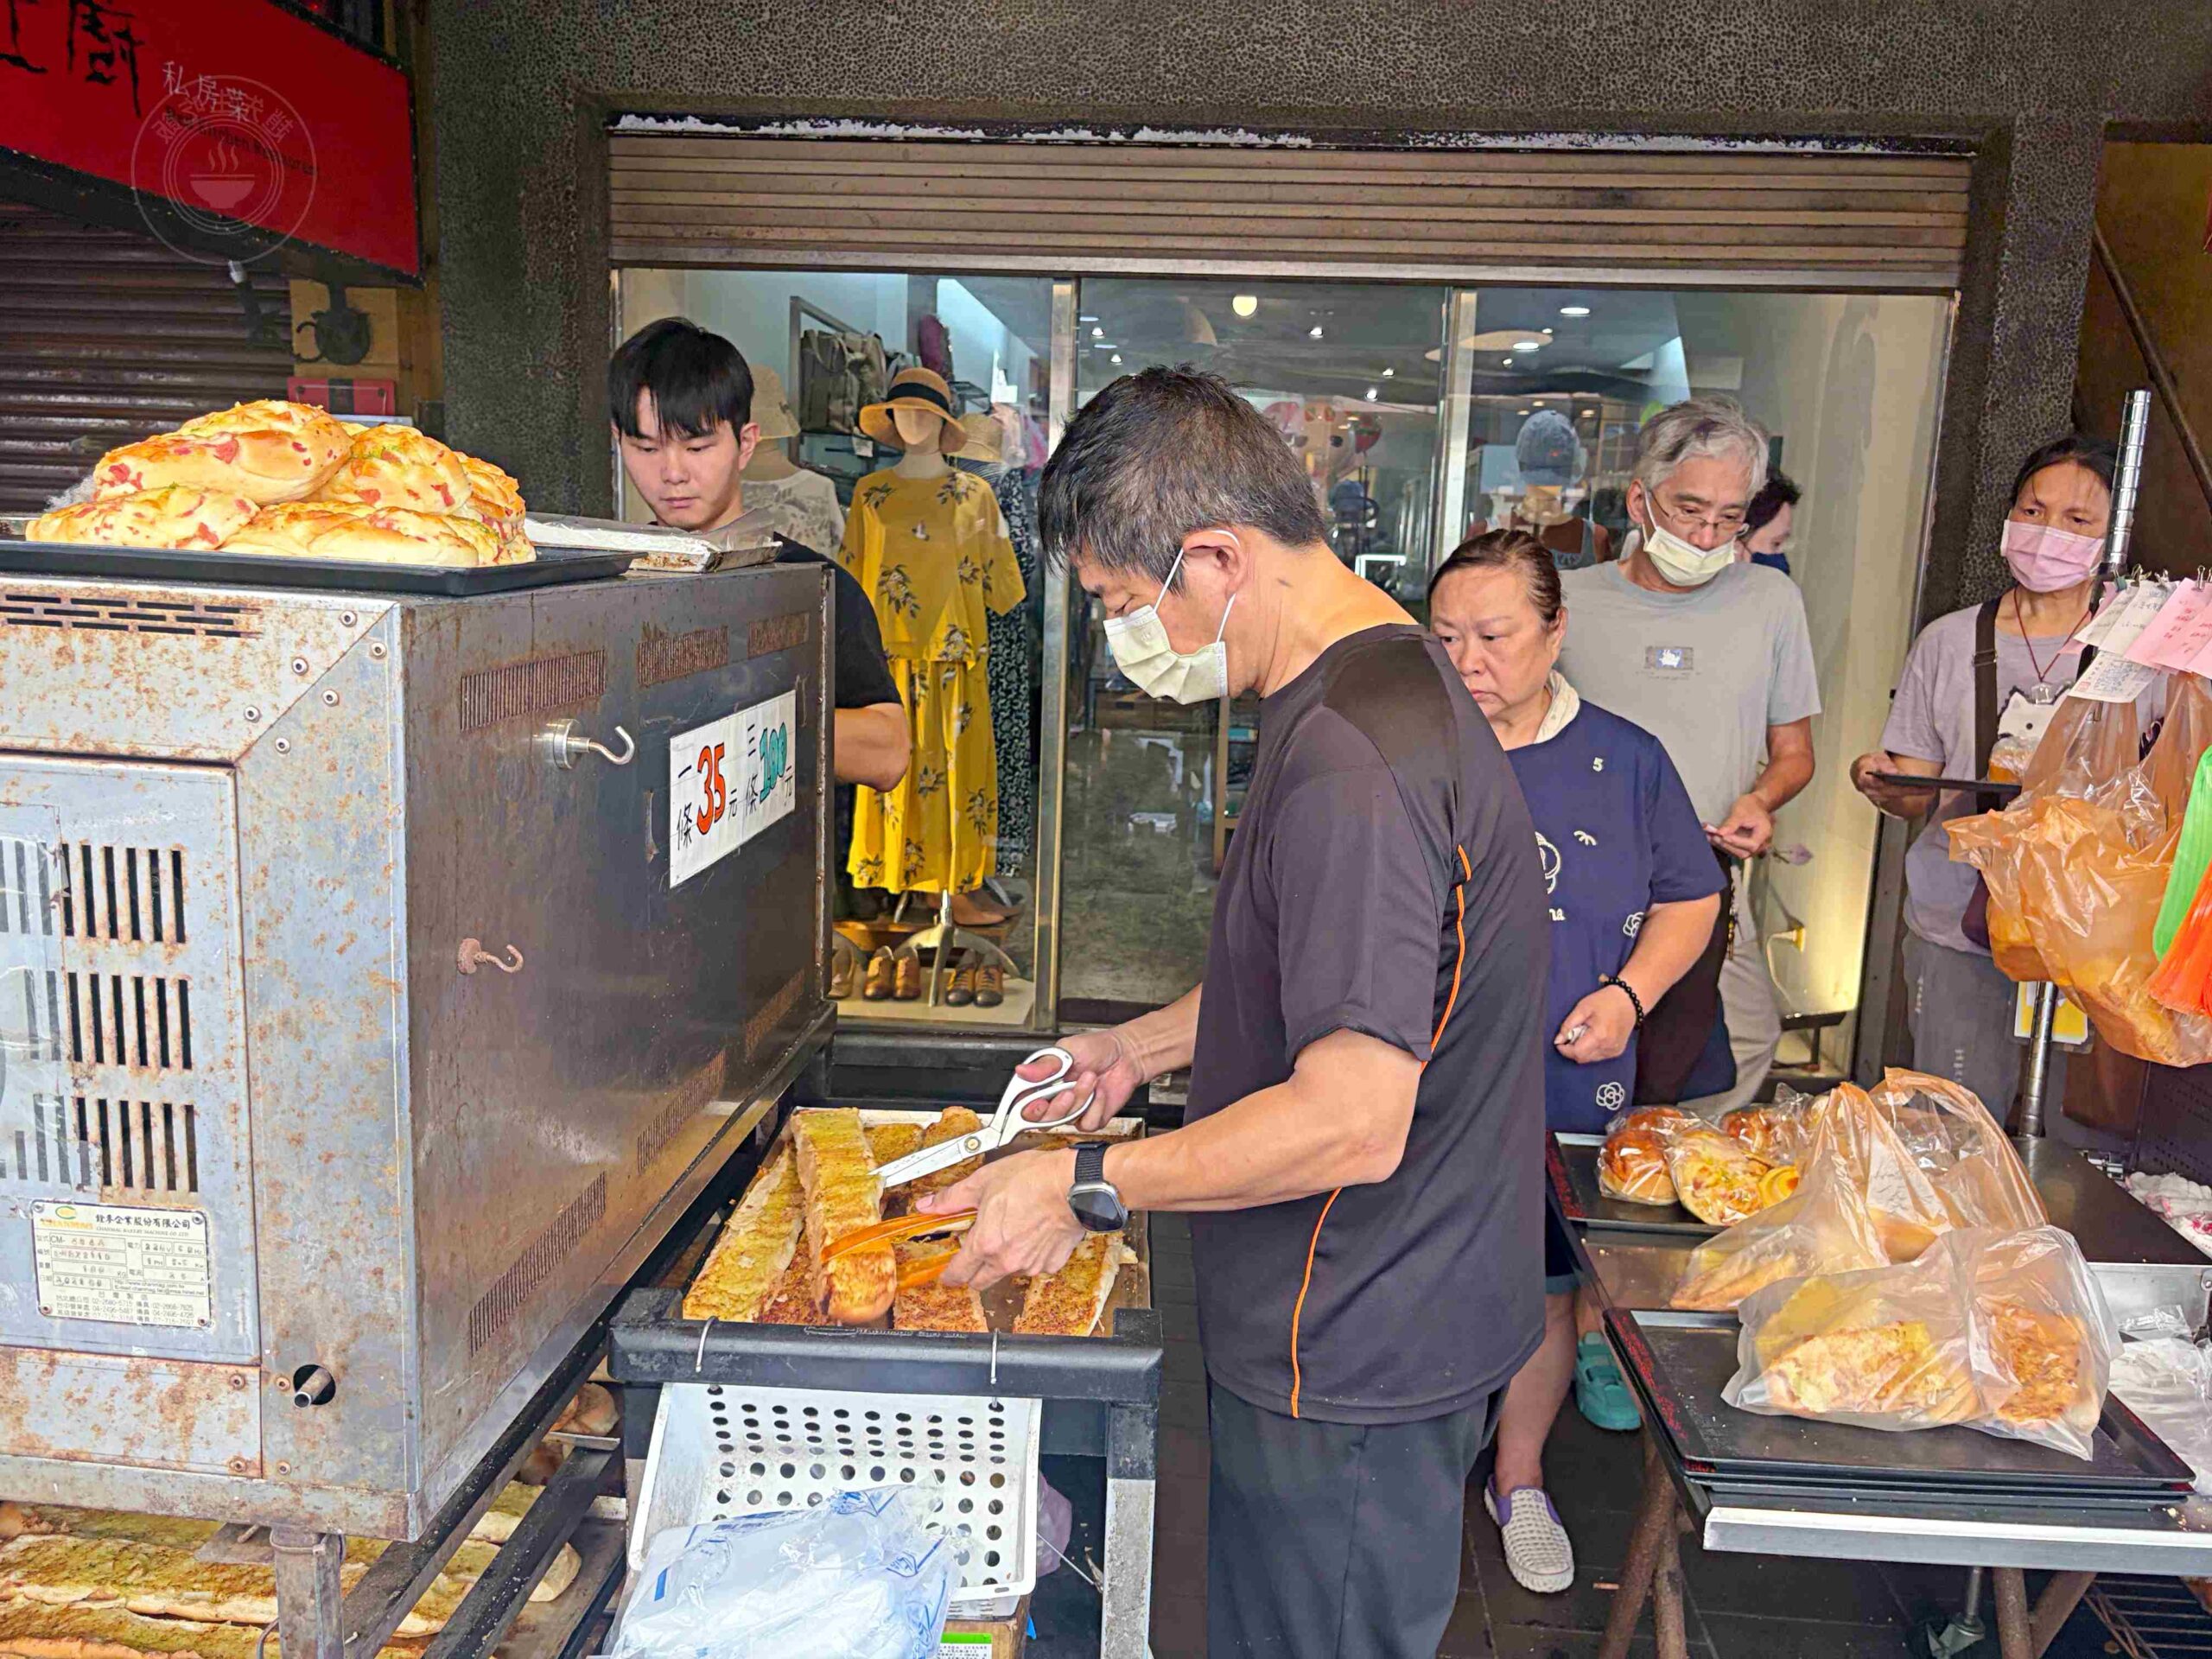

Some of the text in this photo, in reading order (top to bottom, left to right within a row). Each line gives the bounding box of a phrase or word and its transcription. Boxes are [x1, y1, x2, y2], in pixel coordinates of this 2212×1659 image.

[162, 60, 251, 123] 私房菜
[696, 741, 727, 836] 35
[728, 788, 738, 821] 元
[759, 721, 787, 804] 100
[1592, 757, 1604, 772] 5
